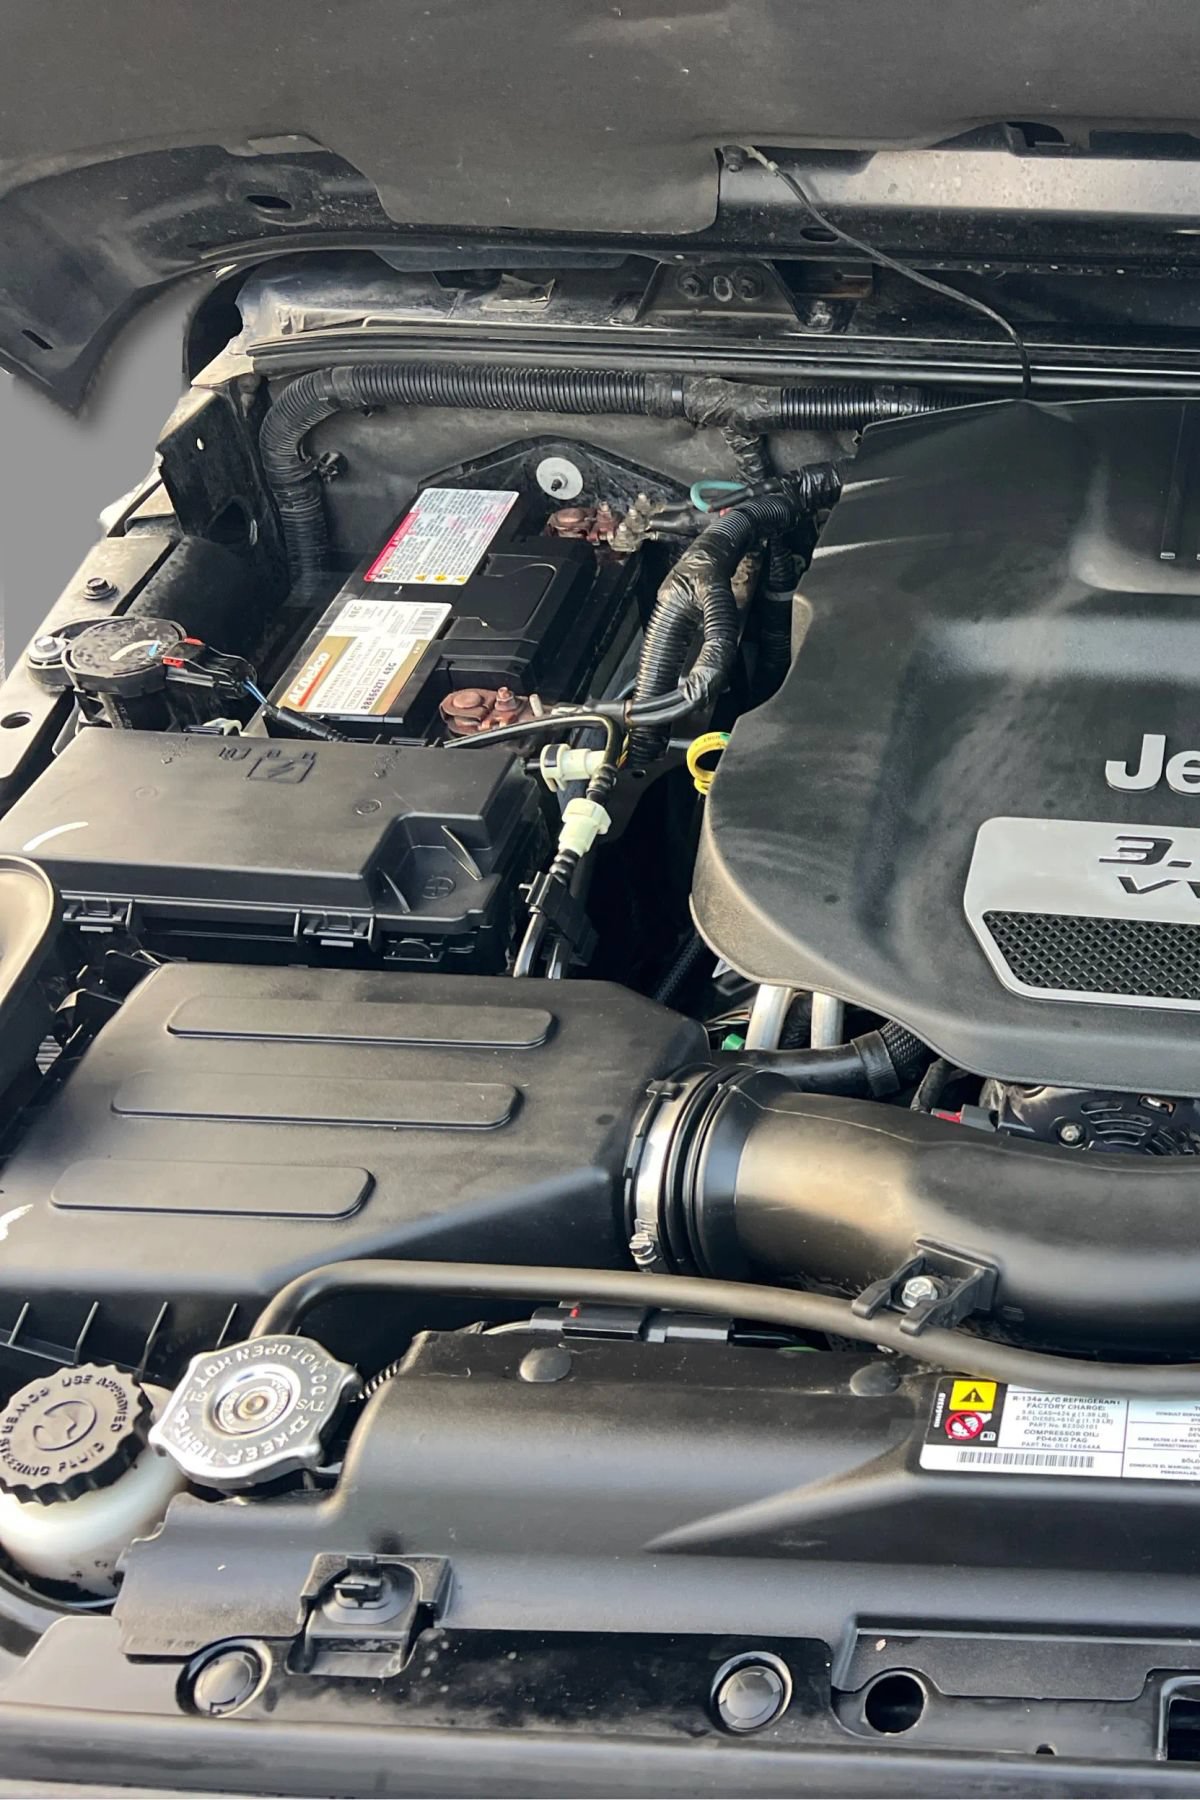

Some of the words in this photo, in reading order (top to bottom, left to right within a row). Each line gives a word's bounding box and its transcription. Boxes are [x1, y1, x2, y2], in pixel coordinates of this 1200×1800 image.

[235, 1344, 291, 1363] OPEN
[61, 1374, 94, 1388] USE
[223, 1433, 289, 1465] KEEP
